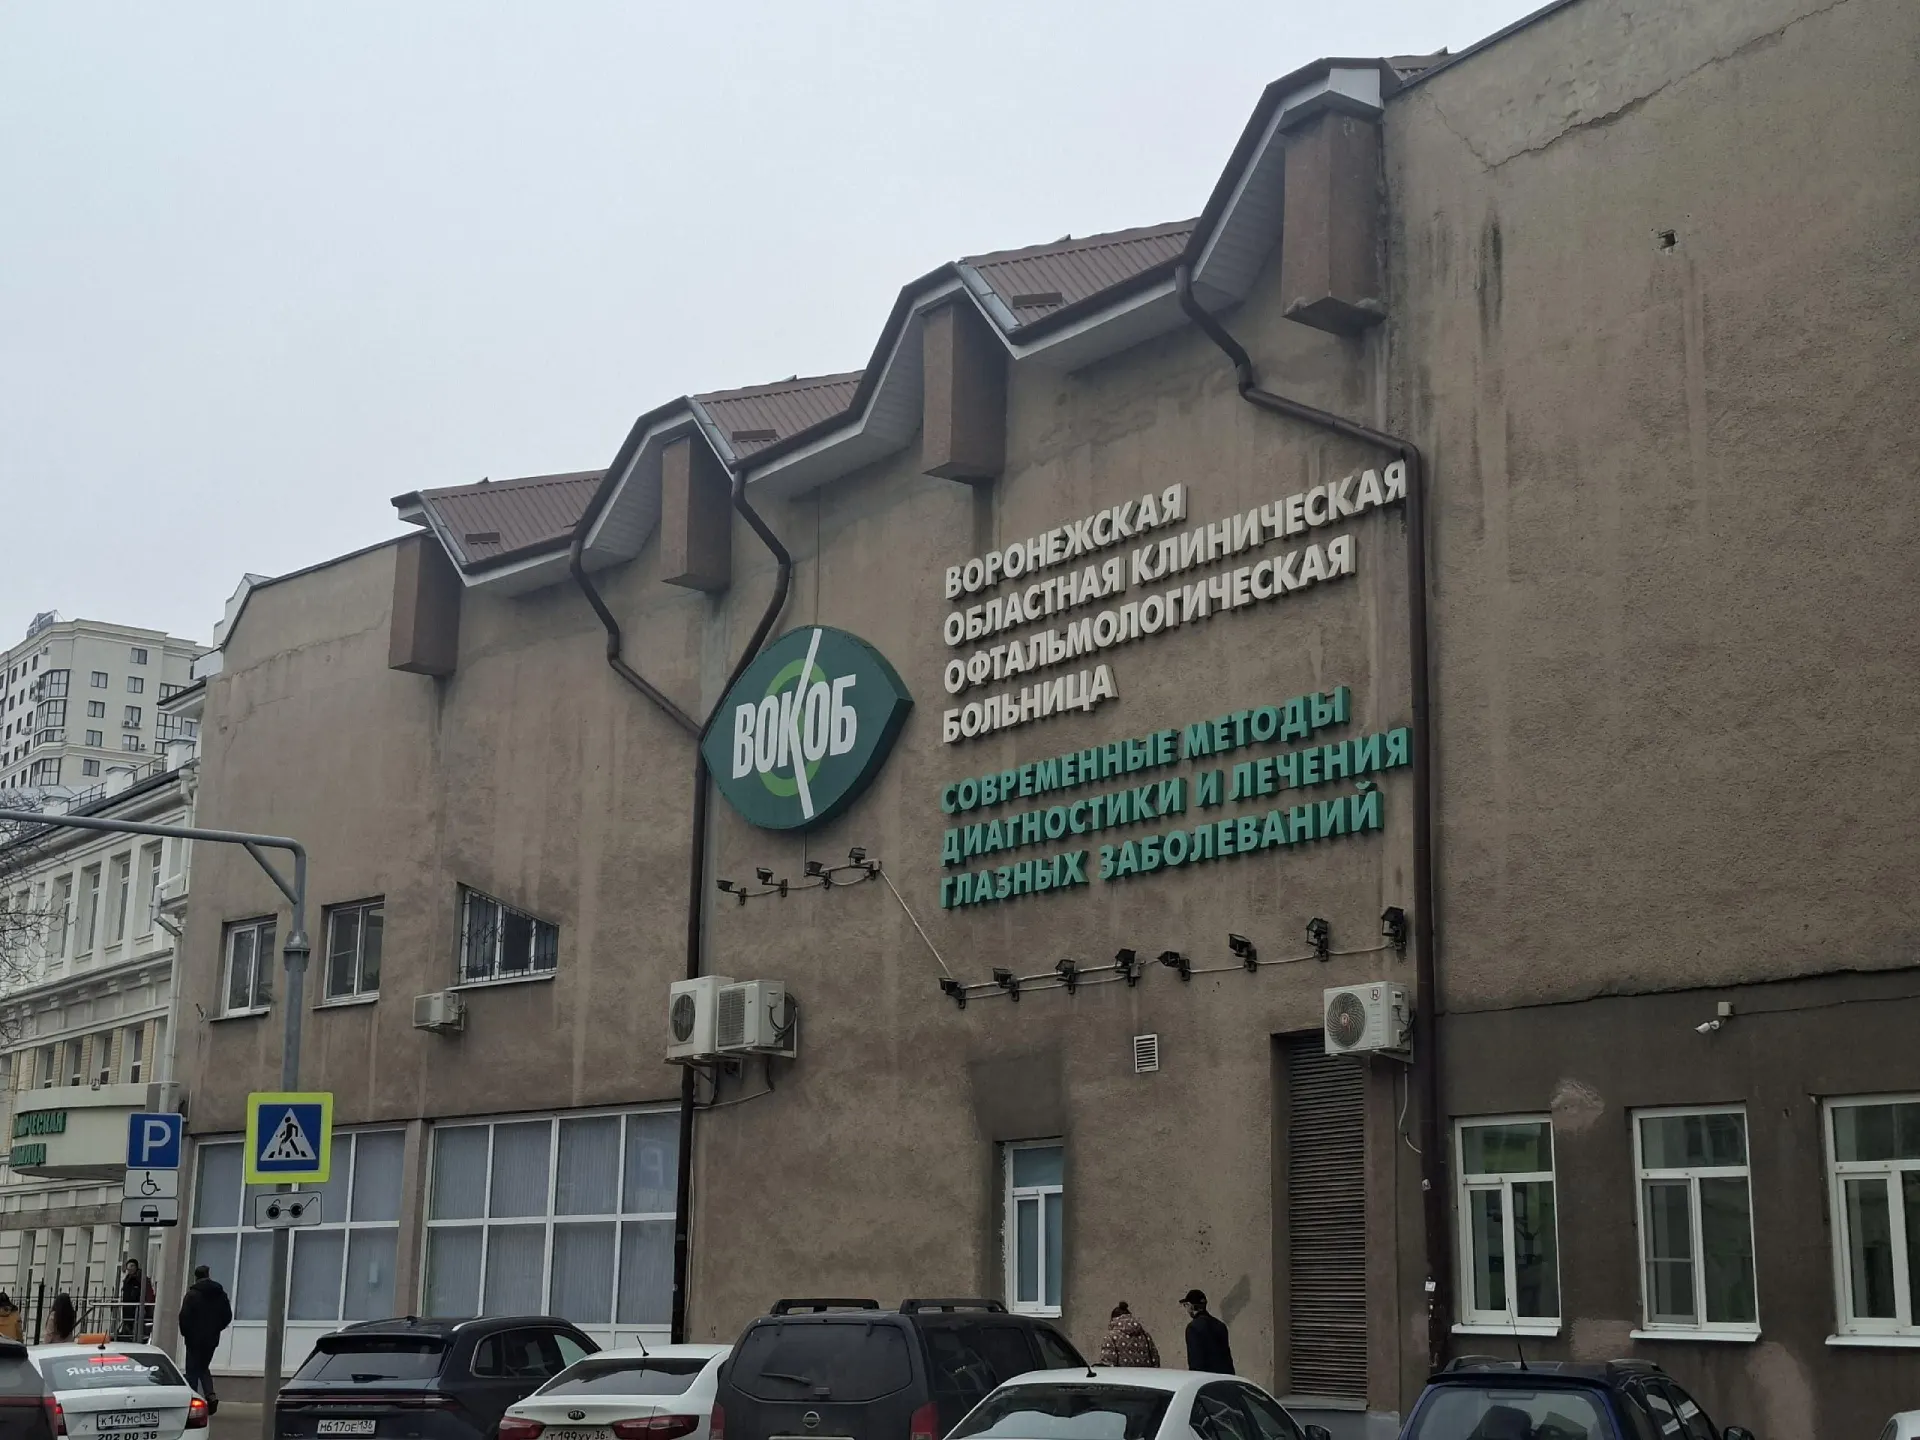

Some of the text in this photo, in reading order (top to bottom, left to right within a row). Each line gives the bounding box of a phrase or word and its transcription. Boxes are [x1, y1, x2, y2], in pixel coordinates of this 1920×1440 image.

[944, 482, 1188, 600] ВОРОНЕЖСКАЯ
[944, 459, 1407, 647] ОБЛАСТНАЯ КЛИНИЧЕСКАЯ
[944, 533, 1356, 695] ОФТАЛЬМОЛОГИЧЕСКАЯ
[732, 628, 857, 820] ВОКОБ
[941, 685, 1351, 814] СОВРЕМЕННЫЕ МЕТОДЫ
[943, 665, 1119, 744] БОЛЬНИЦА
[940, 782, 1384, 909] ГЛАЗНЫХ ЗАБОЛЕВАНИЙ
[941, 727, 1413, 867] ДИАГНОСТИКИ И ЛЕЧЕНИЯ
[142, 1119, 171, 1162] P
[66, 1363, 133, 1377] Яндекс
[142, 1430, 158, 1440] 36
